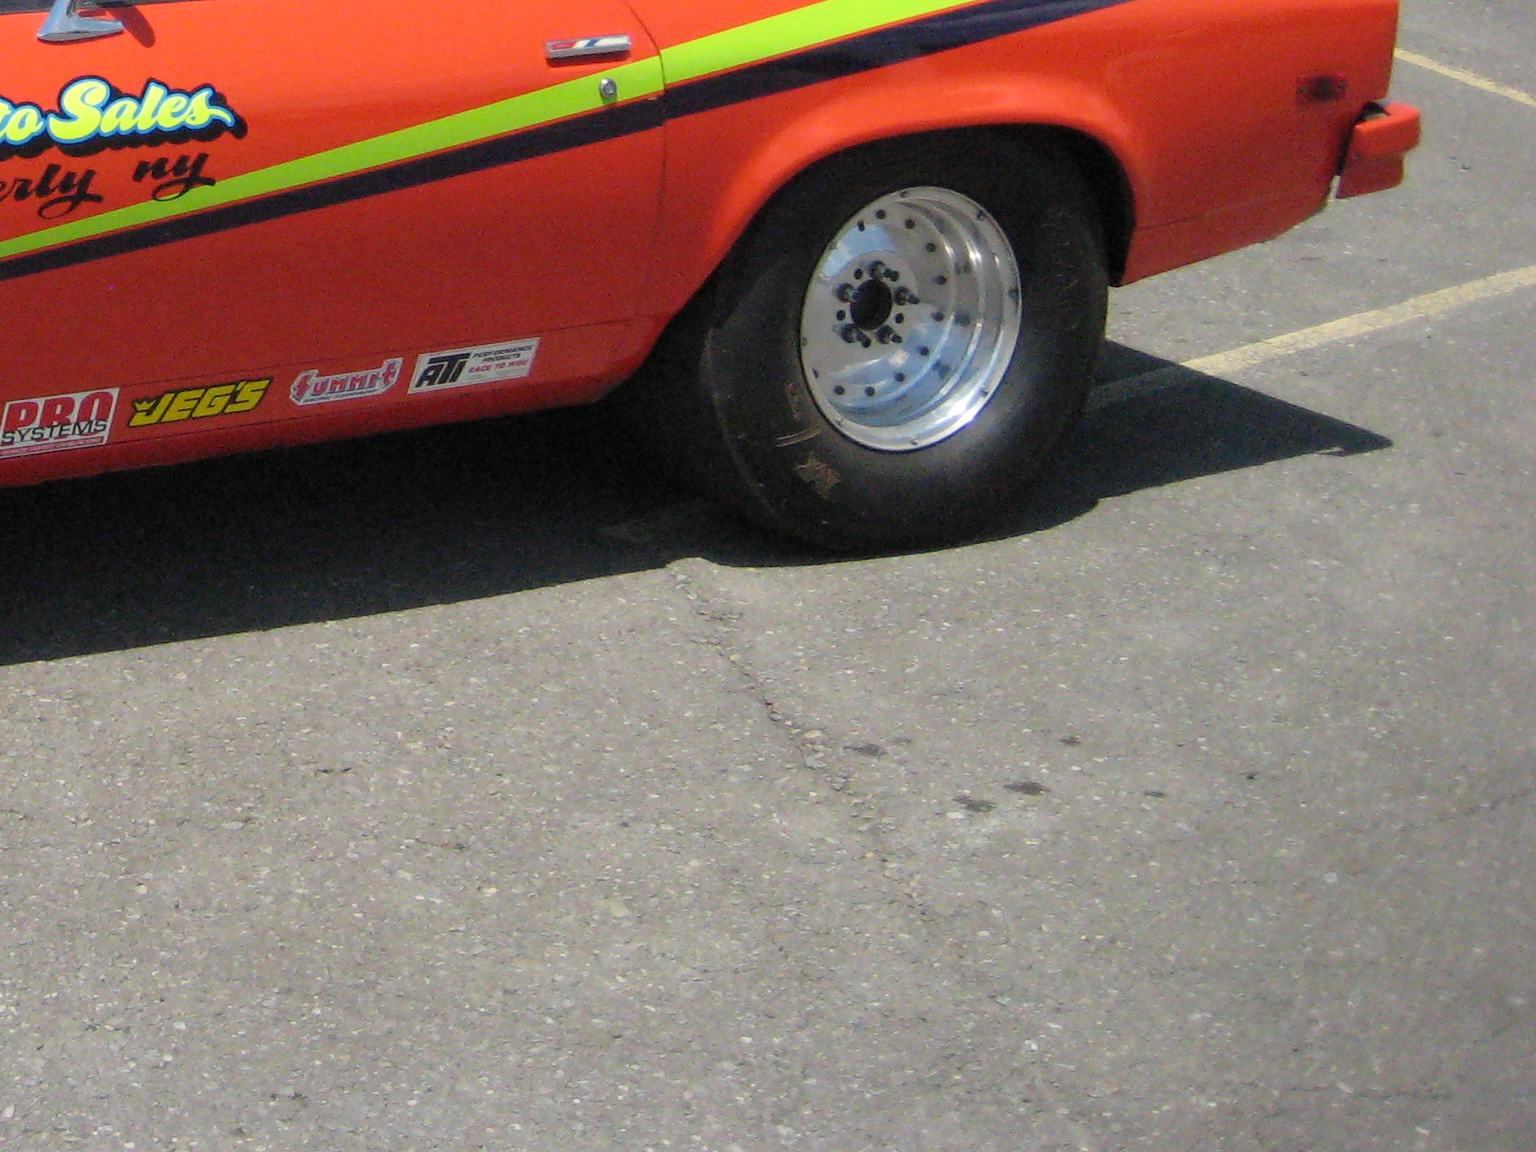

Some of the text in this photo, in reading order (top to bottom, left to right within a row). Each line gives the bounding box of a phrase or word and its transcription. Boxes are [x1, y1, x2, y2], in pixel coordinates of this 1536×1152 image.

[46, 74, 248, 156] Sales
[132, 152, 217, 202] ny
[414, 352, 473, 388] ATI
[2, 391, 114, 436] PRO
[128, 379, 272, 427] JEG'S
[1, 419, 109, 445] SYSTEMS
